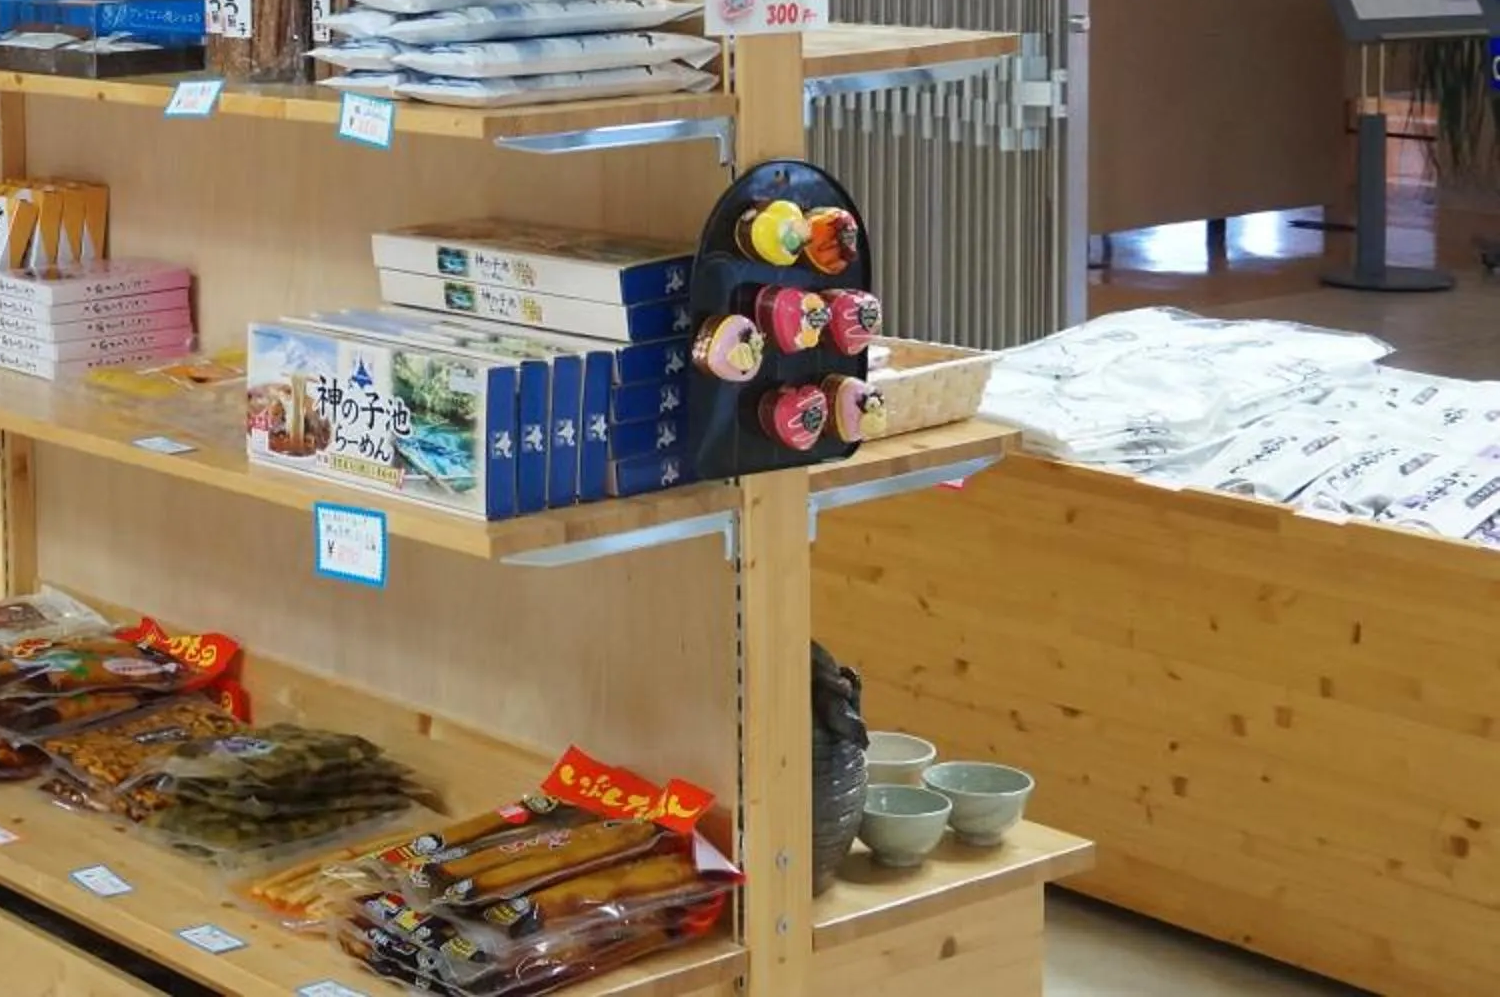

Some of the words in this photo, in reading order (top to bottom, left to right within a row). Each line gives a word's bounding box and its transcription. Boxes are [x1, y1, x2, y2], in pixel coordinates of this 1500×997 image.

[317, 374, 411, 436] 神の子池
[335, 425, 392, 462] らーめん
